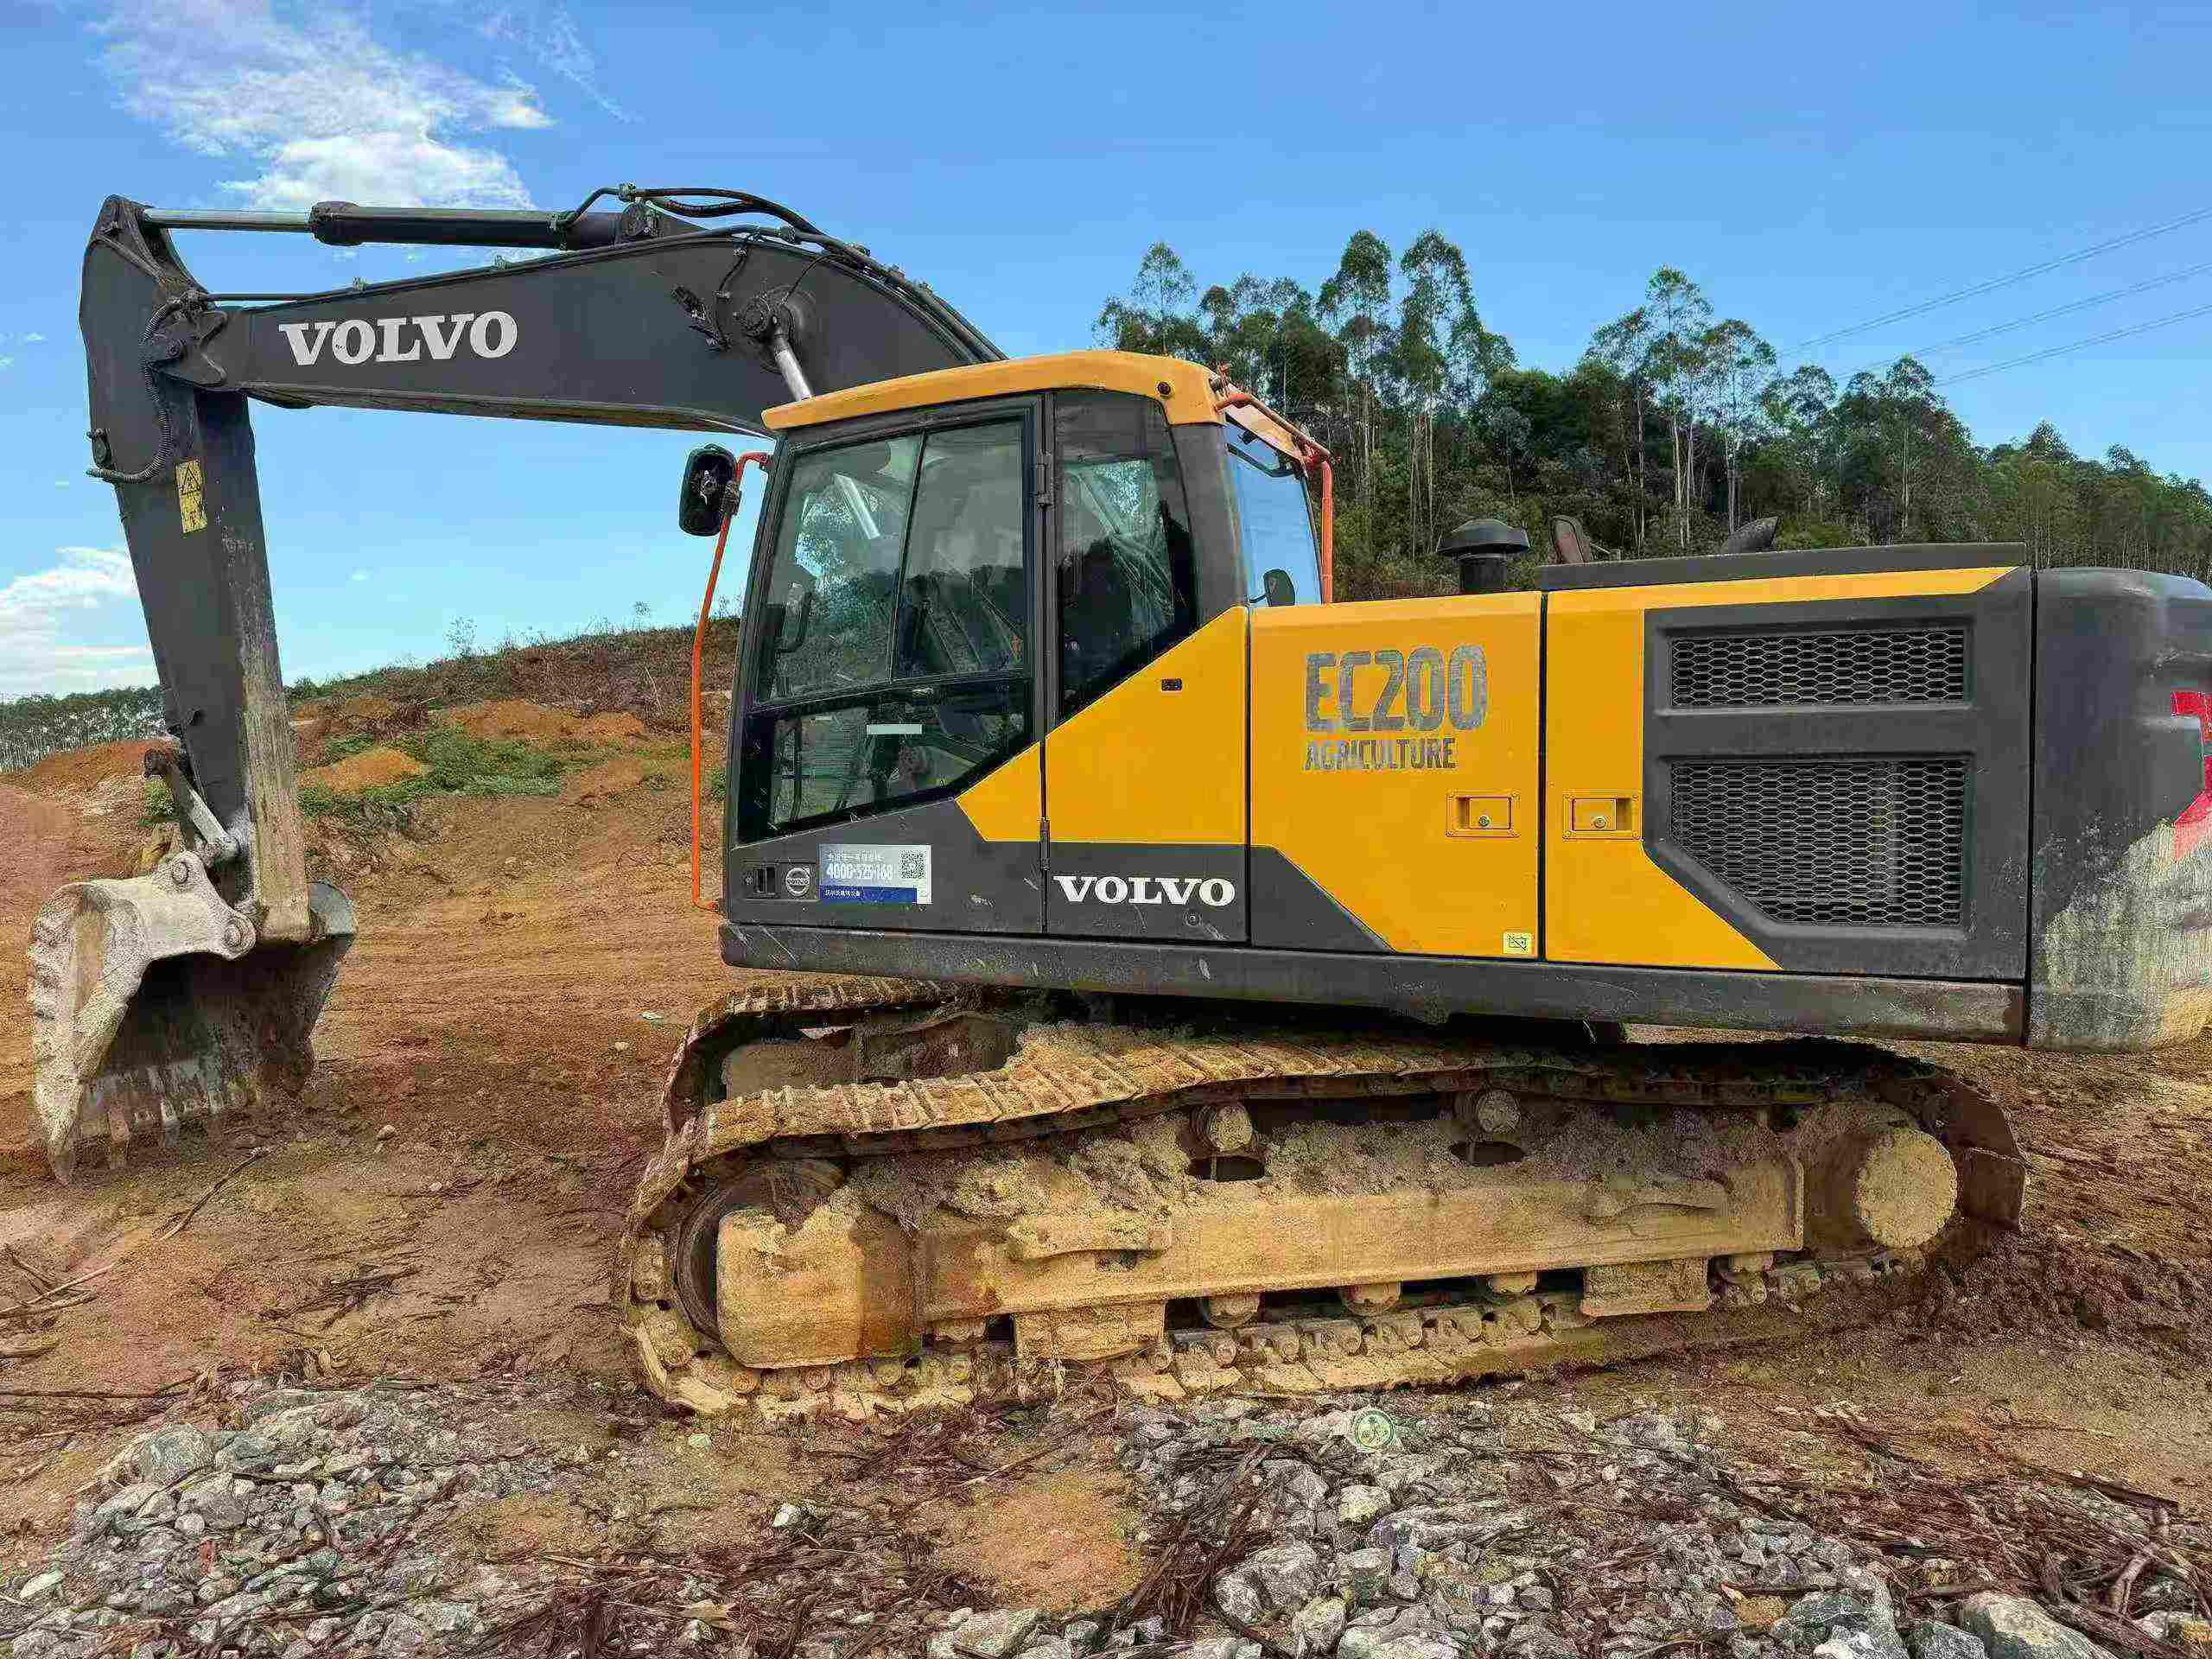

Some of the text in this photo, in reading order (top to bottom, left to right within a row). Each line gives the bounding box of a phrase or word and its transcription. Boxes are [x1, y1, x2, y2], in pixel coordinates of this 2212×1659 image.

[278, 311, 518, 365] VOLVO
[1306, 645, 1487, 731] EC200
[1303, 737, 1458, 770] AGRICULTURE
[1053, 875, 1236, 906] VOLVO
